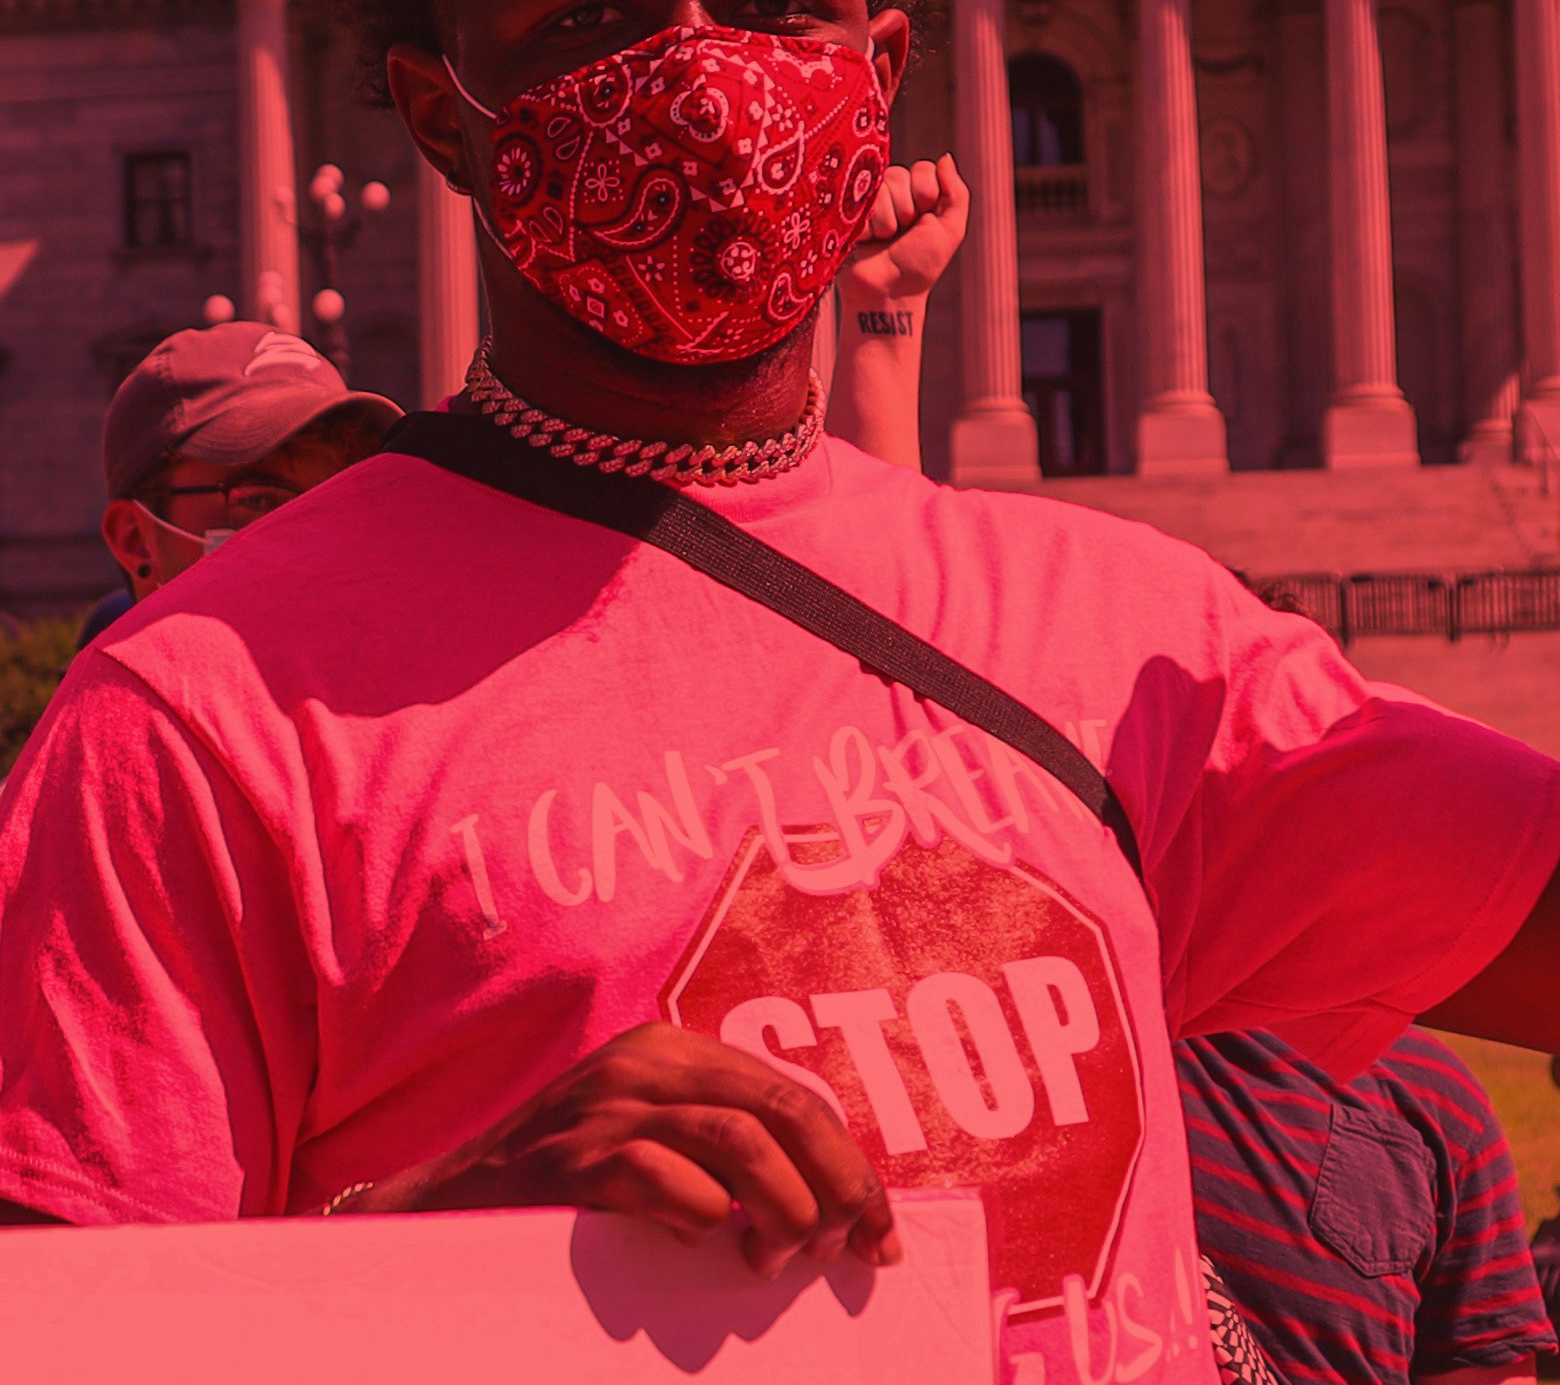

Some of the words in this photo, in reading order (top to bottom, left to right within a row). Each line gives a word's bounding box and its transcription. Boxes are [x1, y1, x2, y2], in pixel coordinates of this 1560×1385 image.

[858, 311, 914, 337] RESIST
[449, 813, 508, 942] I
[527, 747, 786, 907] CAN'T
[719, 954, 1103, 1157] STOP
